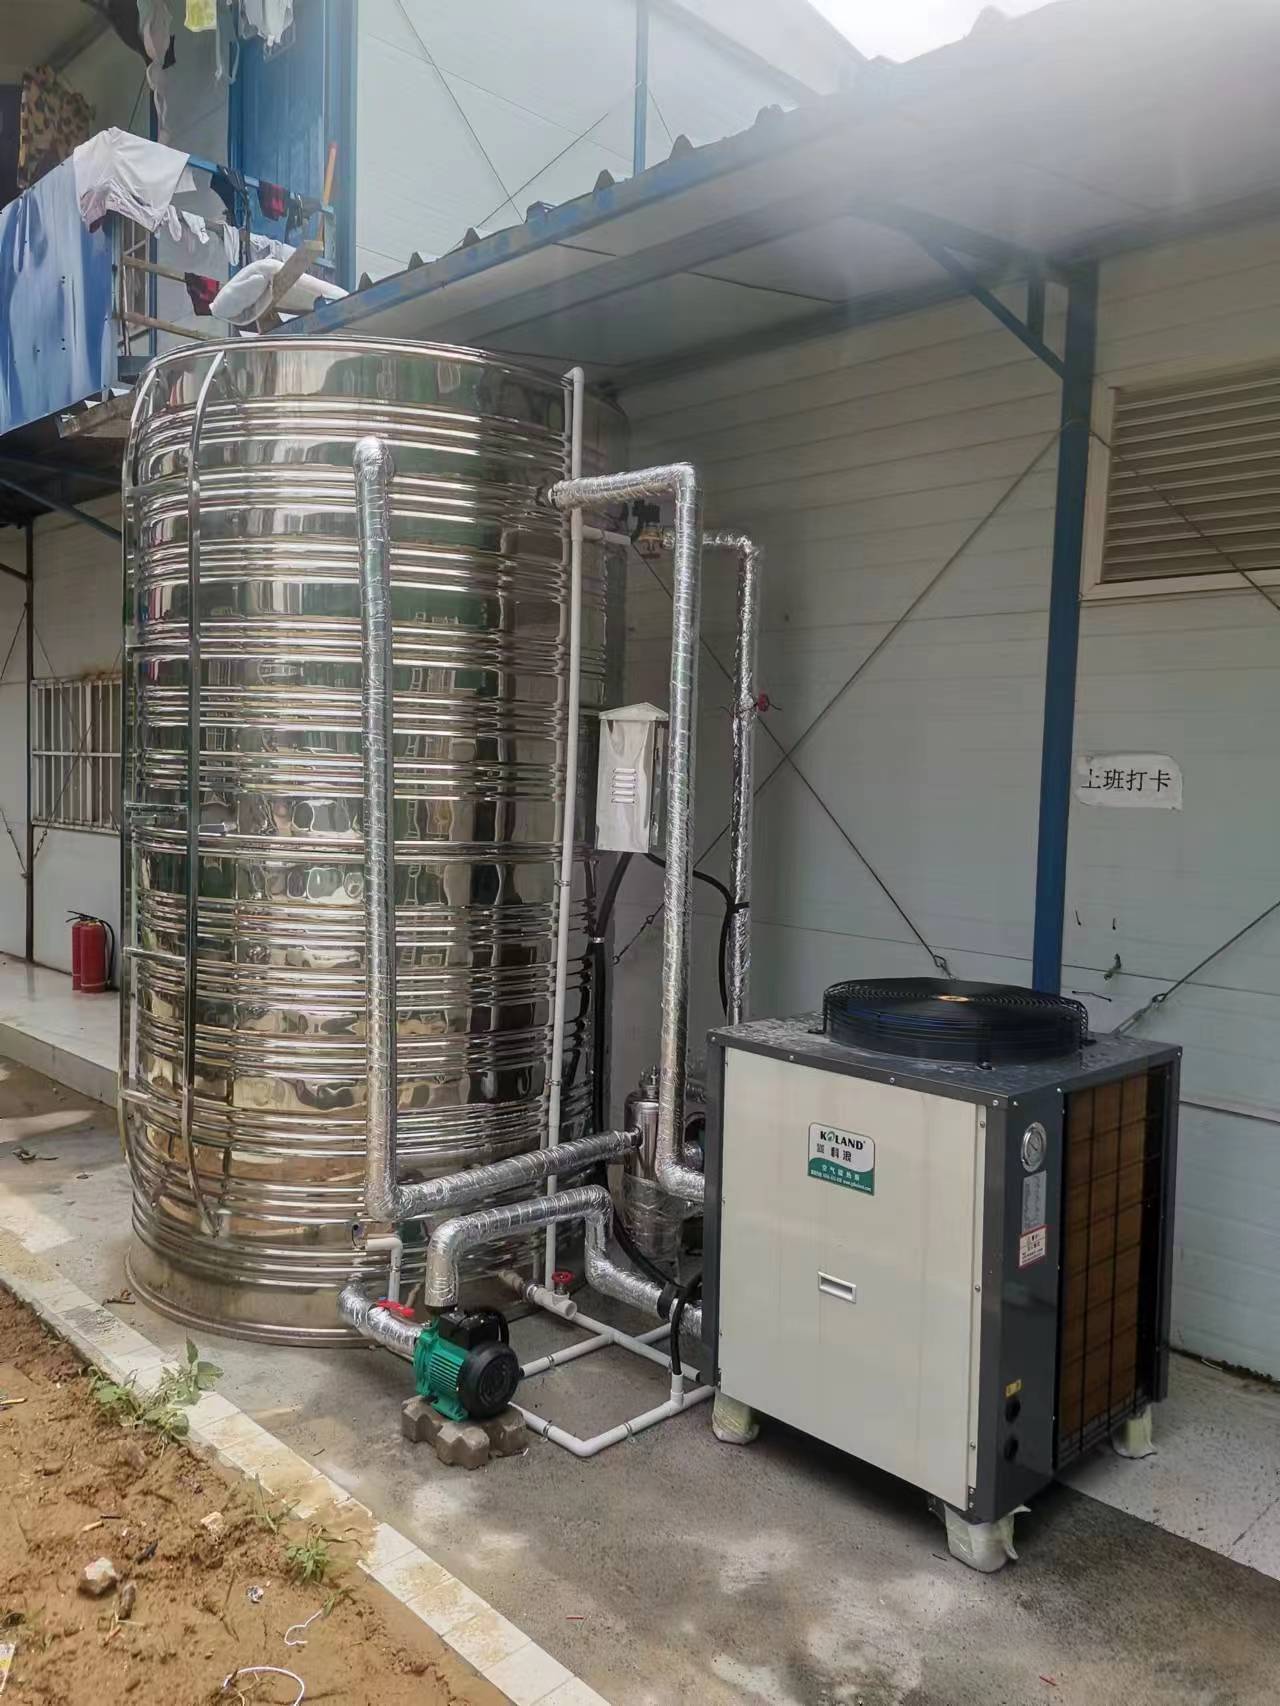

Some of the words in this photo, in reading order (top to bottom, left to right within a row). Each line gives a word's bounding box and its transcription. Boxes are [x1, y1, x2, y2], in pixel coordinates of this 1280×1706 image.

[1080, 768, 1172, 792] 上班打卡
[820, 1130, 864, 1150] KOLAND
